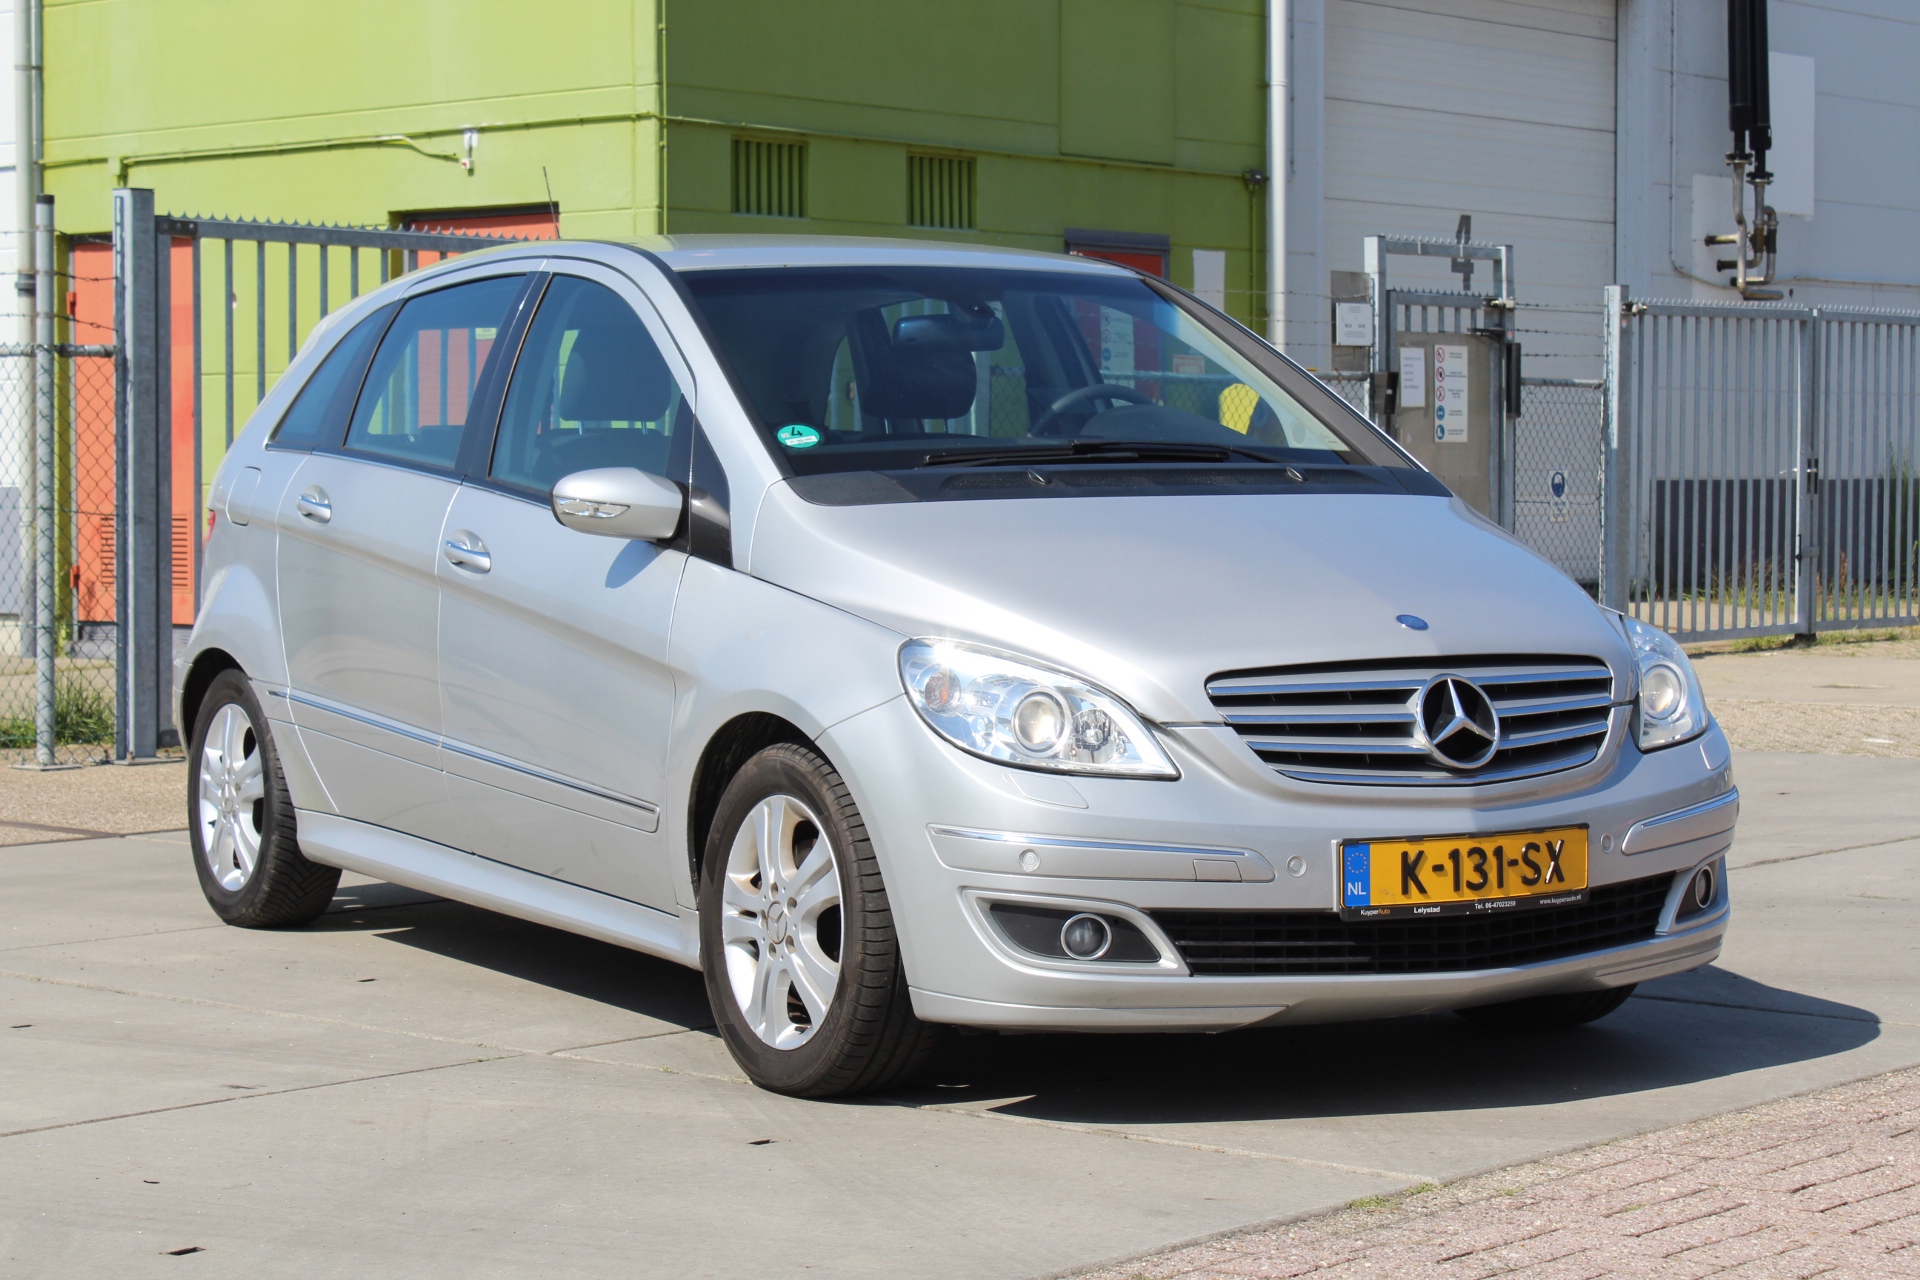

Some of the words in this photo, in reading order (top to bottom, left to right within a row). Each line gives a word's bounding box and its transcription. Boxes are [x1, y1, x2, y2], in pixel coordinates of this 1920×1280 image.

[1451, 214, 1475, 291] 4
[791, 427, 803, 436] 4
[1400, 839, 1566, 895] K-131-SX
[1347, 882, 1367, 896] NL
[1413, 906, 1441, 915] Lelystad
